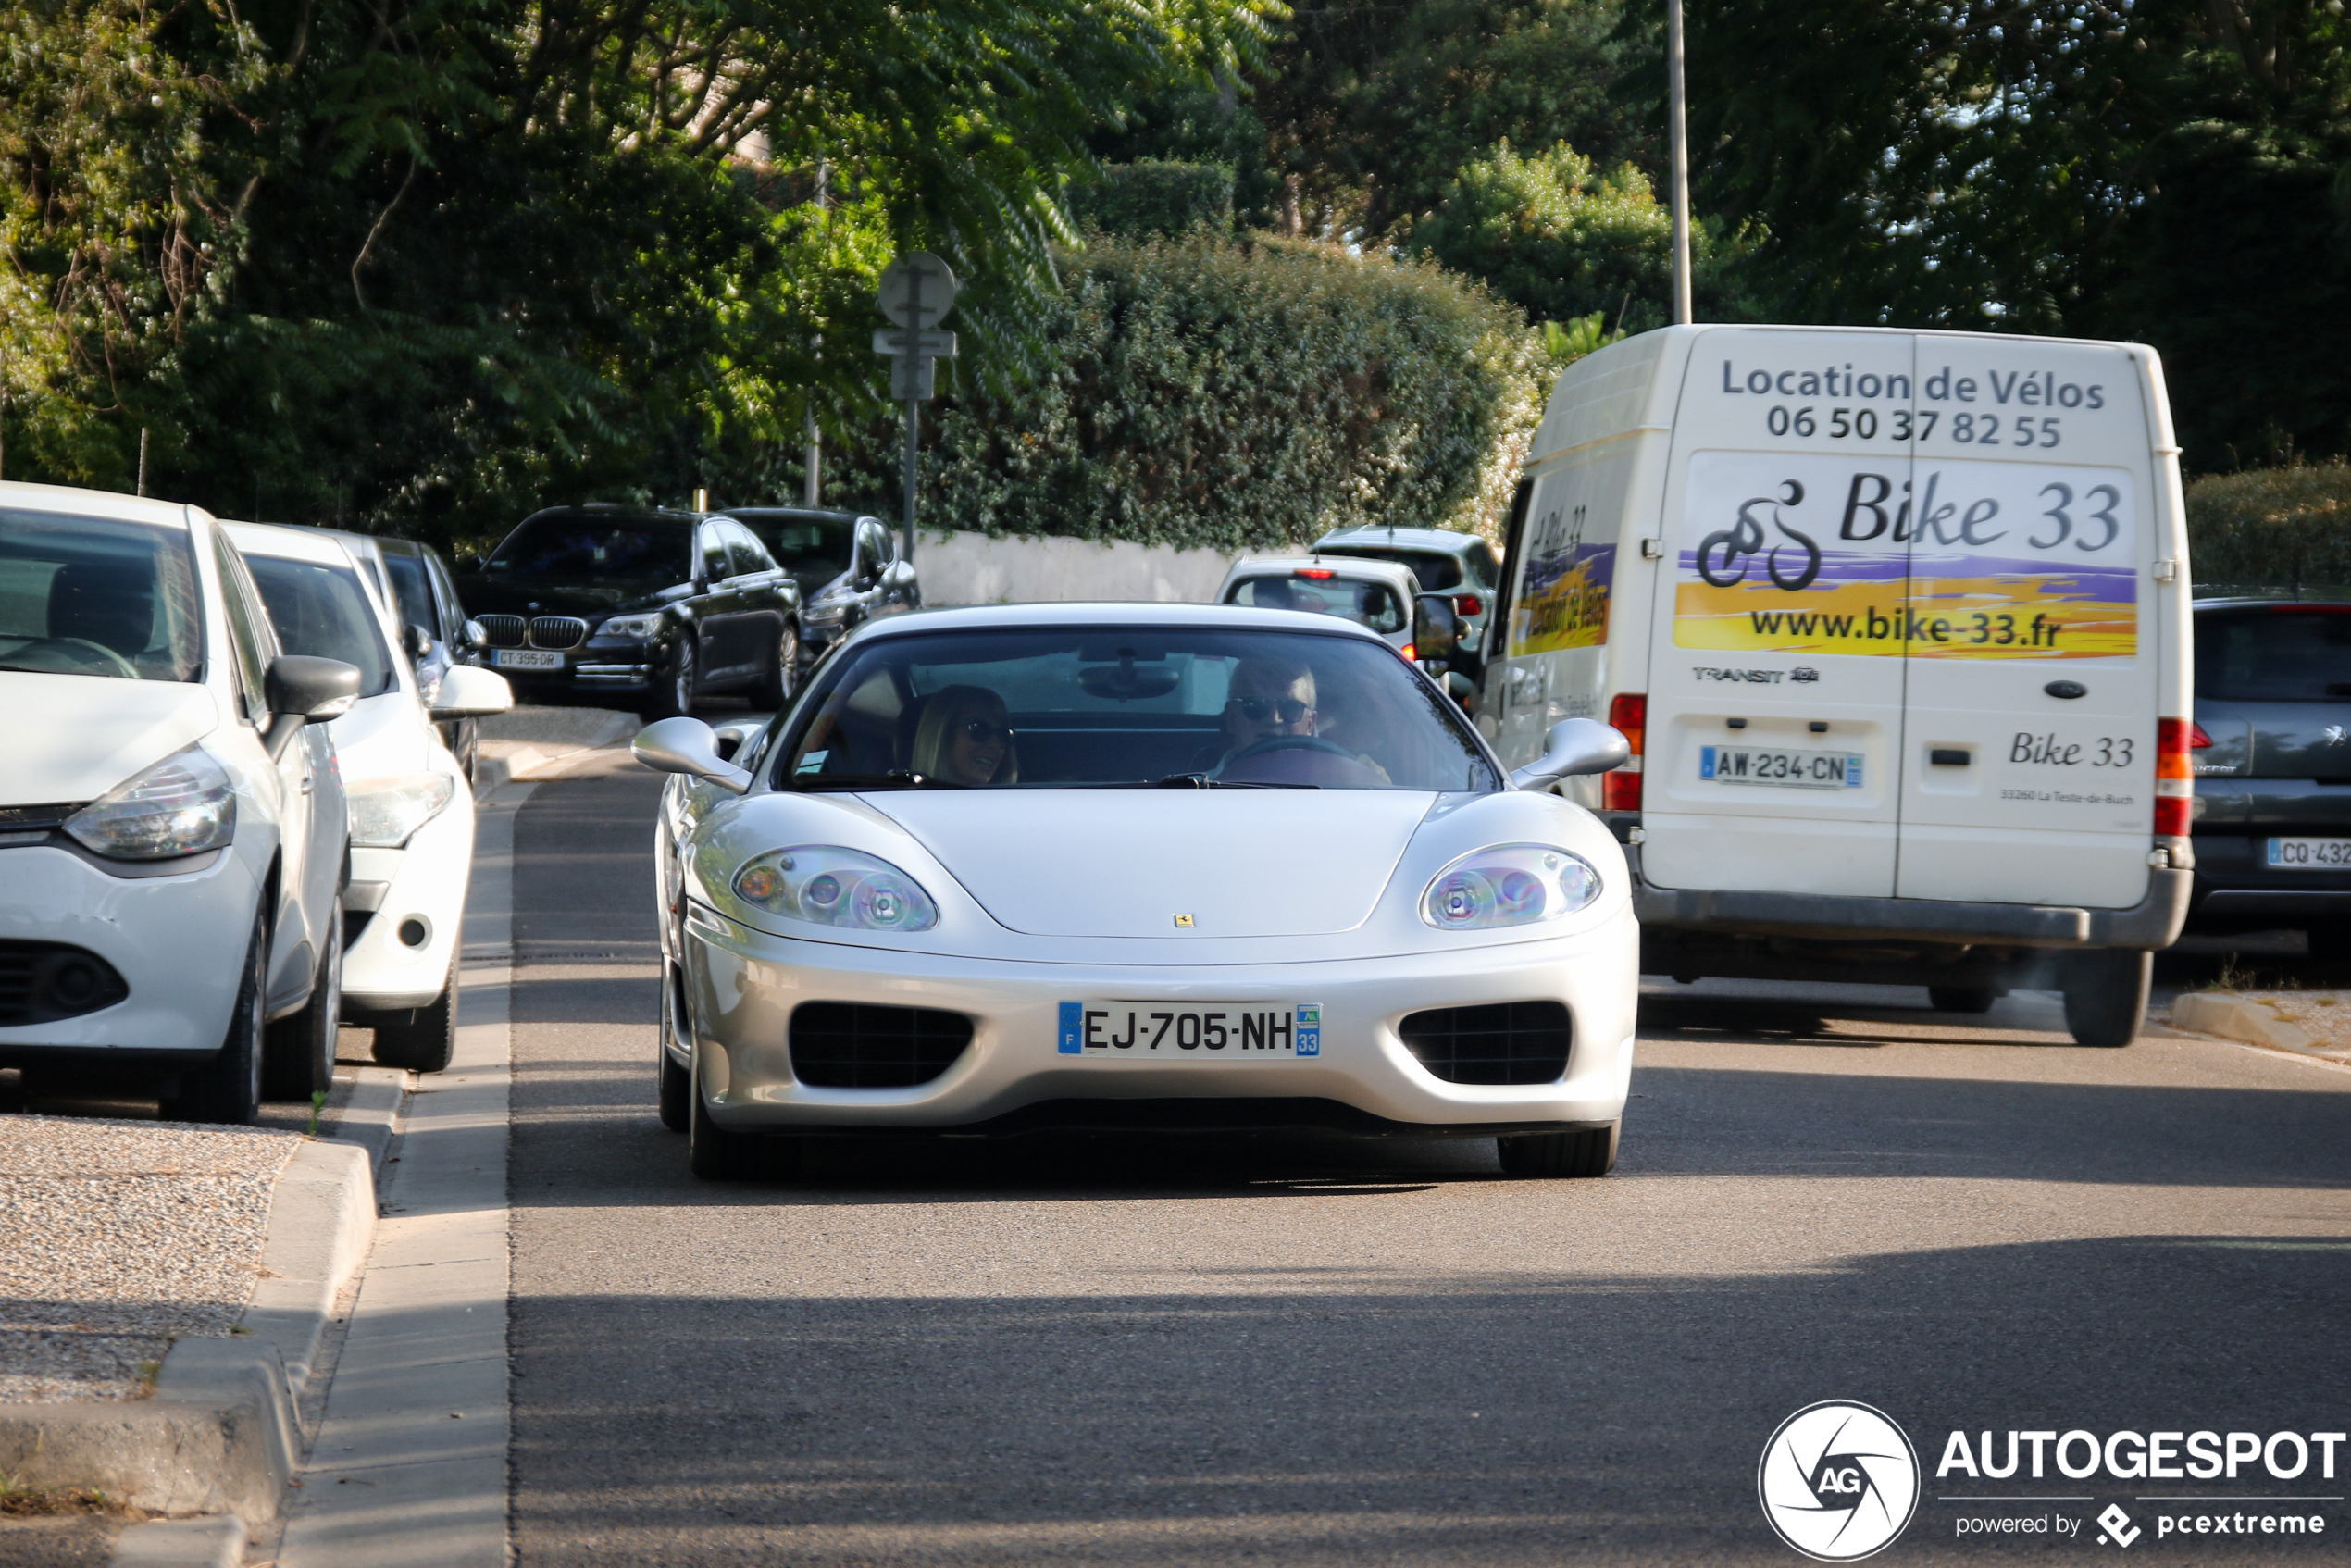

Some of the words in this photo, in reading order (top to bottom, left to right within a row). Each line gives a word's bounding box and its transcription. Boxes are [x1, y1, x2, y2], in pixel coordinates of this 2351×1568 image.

[1723, 359, 1911, 401] Location
[1926, 366, 1978, 403] de
[1988, 368, 2105, 410] Vélos
[1767, 404, 1816, 438] 06
[1830, 407, 1878, 441] 50
[1891, 408, 1939, 442] 37
[1951, 412, 2000, 445] 82
[2013, 415, 2061, 449] 55
[1838, 468, 2010, 547] Bike
[2028, 481, 2121, 553] 33
[1750, 604, 2063, 649] www.bike-33.fr
[1692, 666, 1785, 684] TRANSIT
[1717, 752, 1845, 780] AW-234-CN
[2009, 731, 2084, 765] Bike
[2092, 737, 2134, 768] 33
[2000, 789, 2034, 801] 33260
[2037, 791, 2051, 802] La
[1066, 1034, 1074, 1045] F
[1085, 1010, 1292, 1051] EJ-705-NH
[1299, 1033, 1317, 1052] 33
